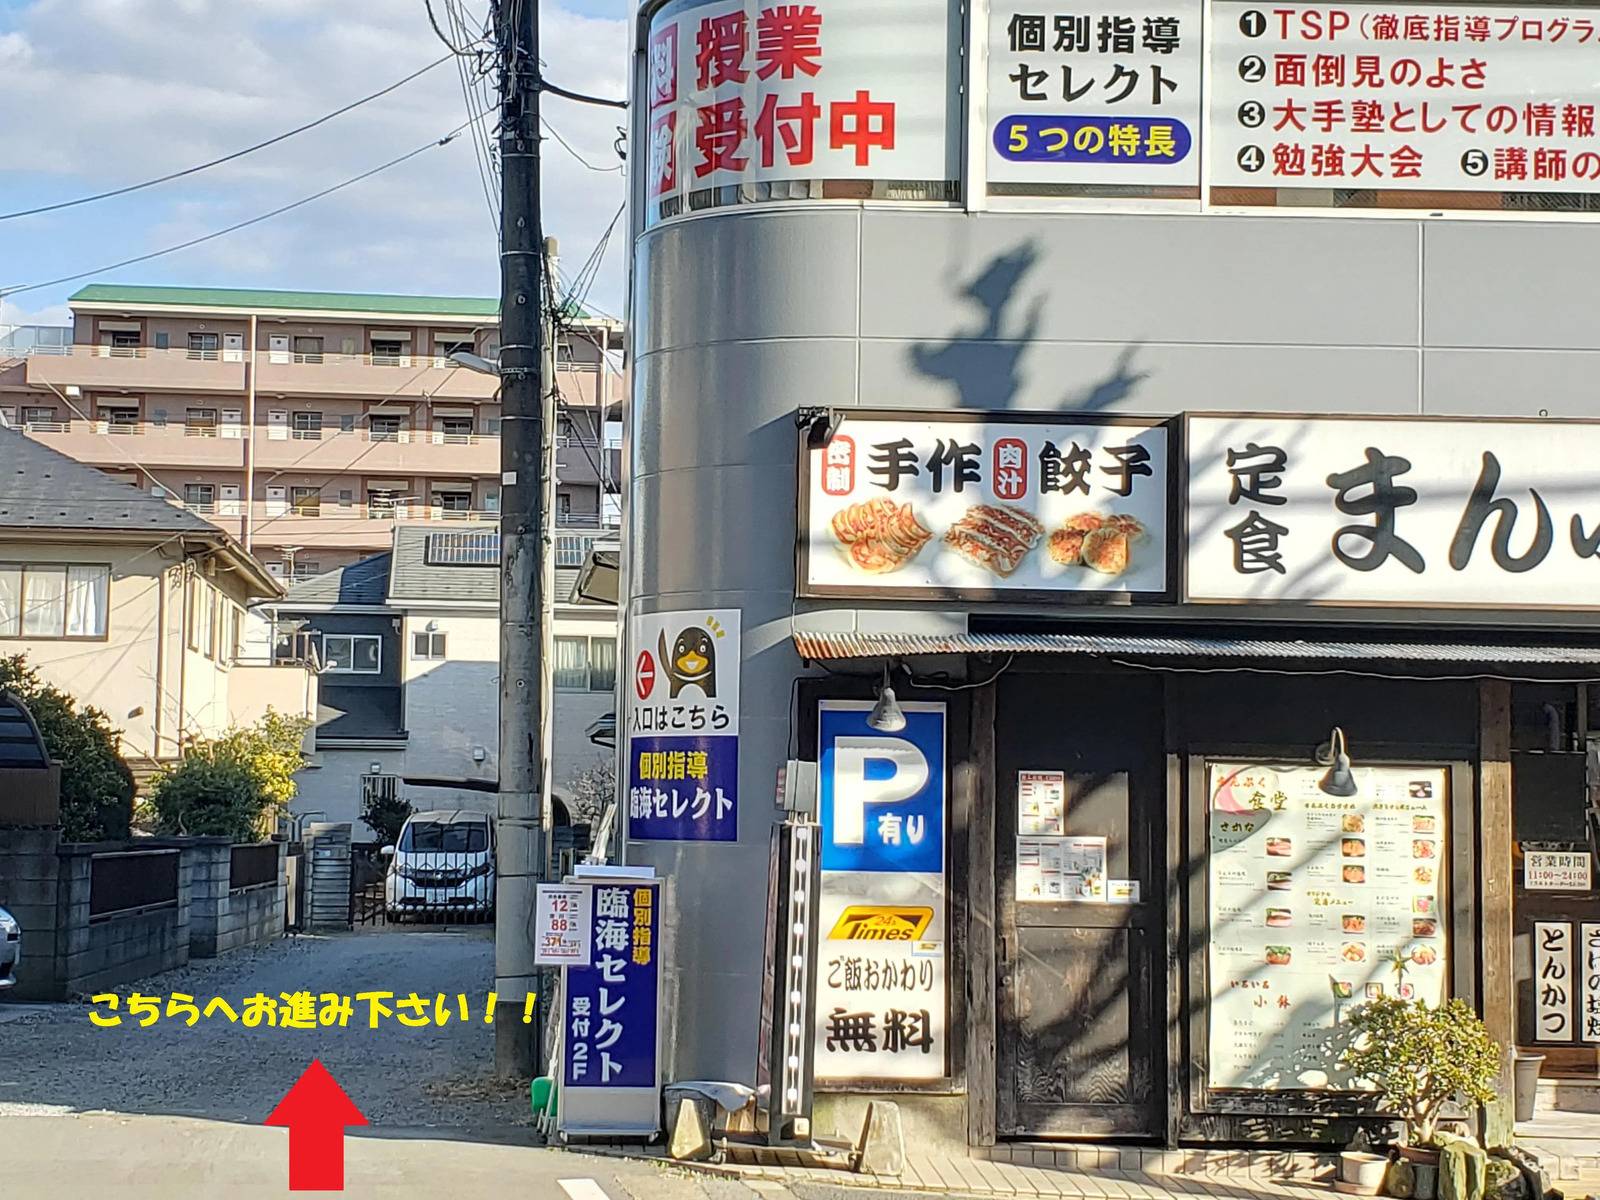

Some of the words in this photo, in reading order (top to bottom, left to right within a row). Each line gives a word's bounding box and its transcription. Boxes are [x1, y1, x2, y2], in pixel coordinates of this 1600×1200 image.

[1007, 13, 1180, 54] 個別指導
[1273, 10, 1600, 42] TSP（徹底指導プログラ
[696, 5, 822, 91] 授業
[1008, 63, 1179, 104] セレクト
[1274, 54, 1488, 89] 面倒見のよさ
[695, 90, 896, 178] 受付中
[1272, 98, 1596, 138] 大手塾としての情報
[1008, 124, 1176, 157] 5つの特長
[1272, 143, 1423, 179] 勉強大会
[867, 438, 982, 493] 手作
[1038, 440, 1154, 497] 餃子
[1223, 442, 1289, 575] 定食
[632, 704, 730, 733] 入口はこちら
[639, 750, 709, 781] 個別指導
[629, 785, 734, 822] 臨海セレクト
[833, 735, 930, 845] P
[877, 813, 925, 845] 有り
[551, 900, 568, 912] 12
[551, 920, 568, 931] 88
[632, 888, 652, 966] 個別指導
[847, 922, 915, 941] Times
[595, 886, 631, 1083] 臨海セレクト
[827, 955, 935, 993] ご飯おかわり
[1542, 928, 1566, 1033] とんかつ
[571, 996, 591, 1081] 受付2F
[825, 1005, 935, 1055] 無料
